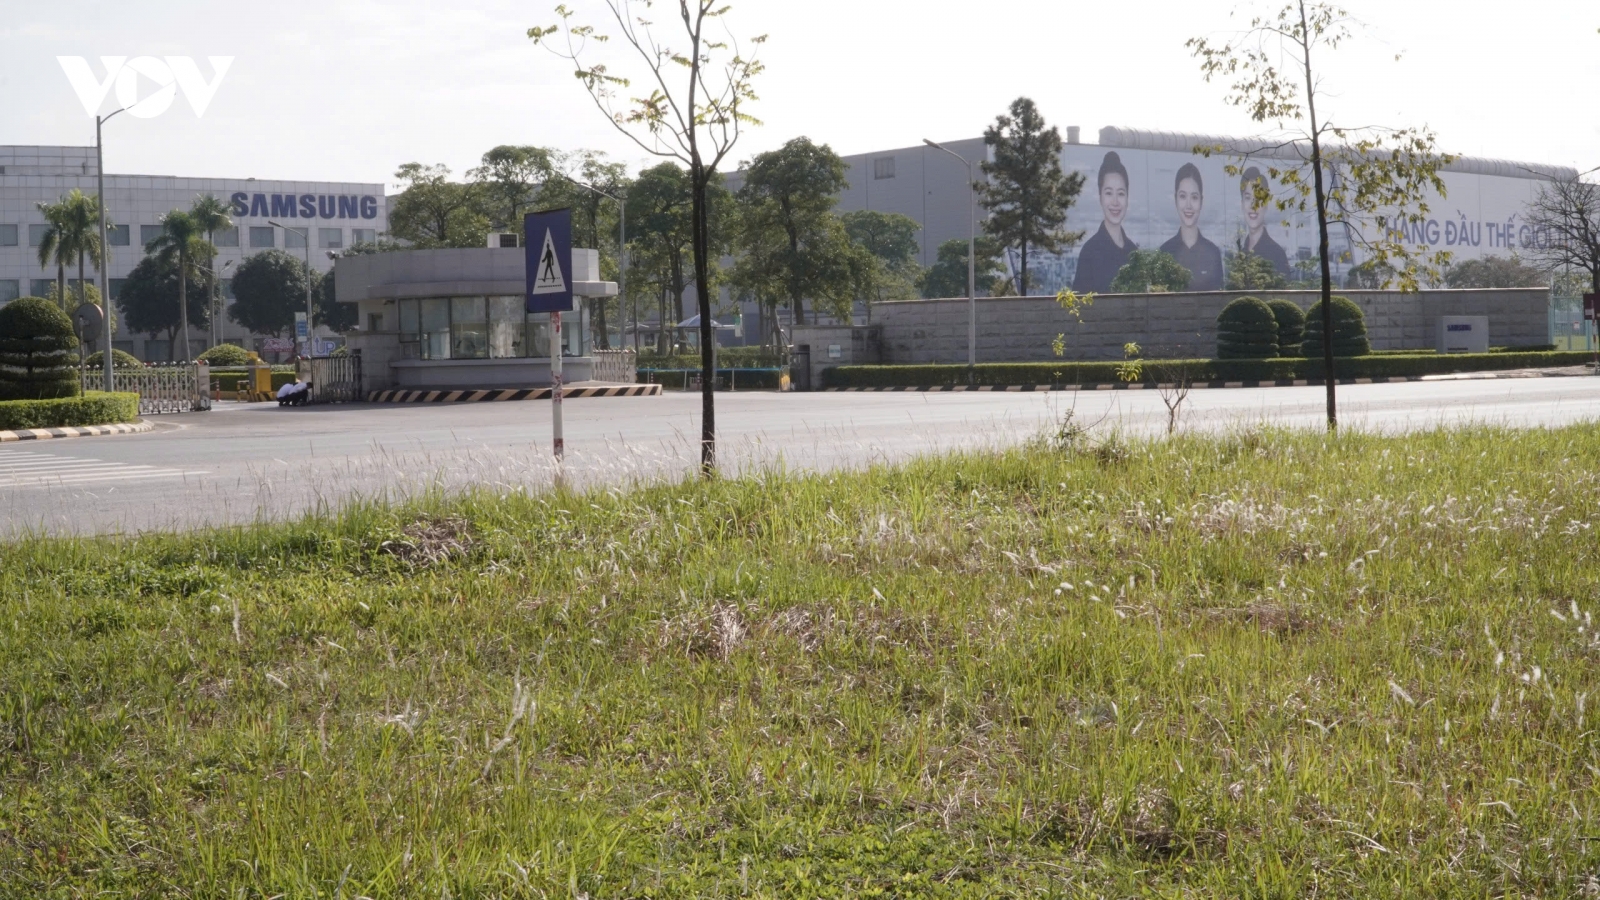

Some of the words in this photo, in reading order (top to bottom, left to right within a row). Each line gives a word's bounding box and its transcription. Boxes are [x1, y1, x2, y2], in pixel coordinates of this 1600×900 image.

[231, 192, 377, 219] SAMSUNG
[1445, 209, 1480, 247] ĐẦU
[1486, 213, 1516, 248] THẾ
